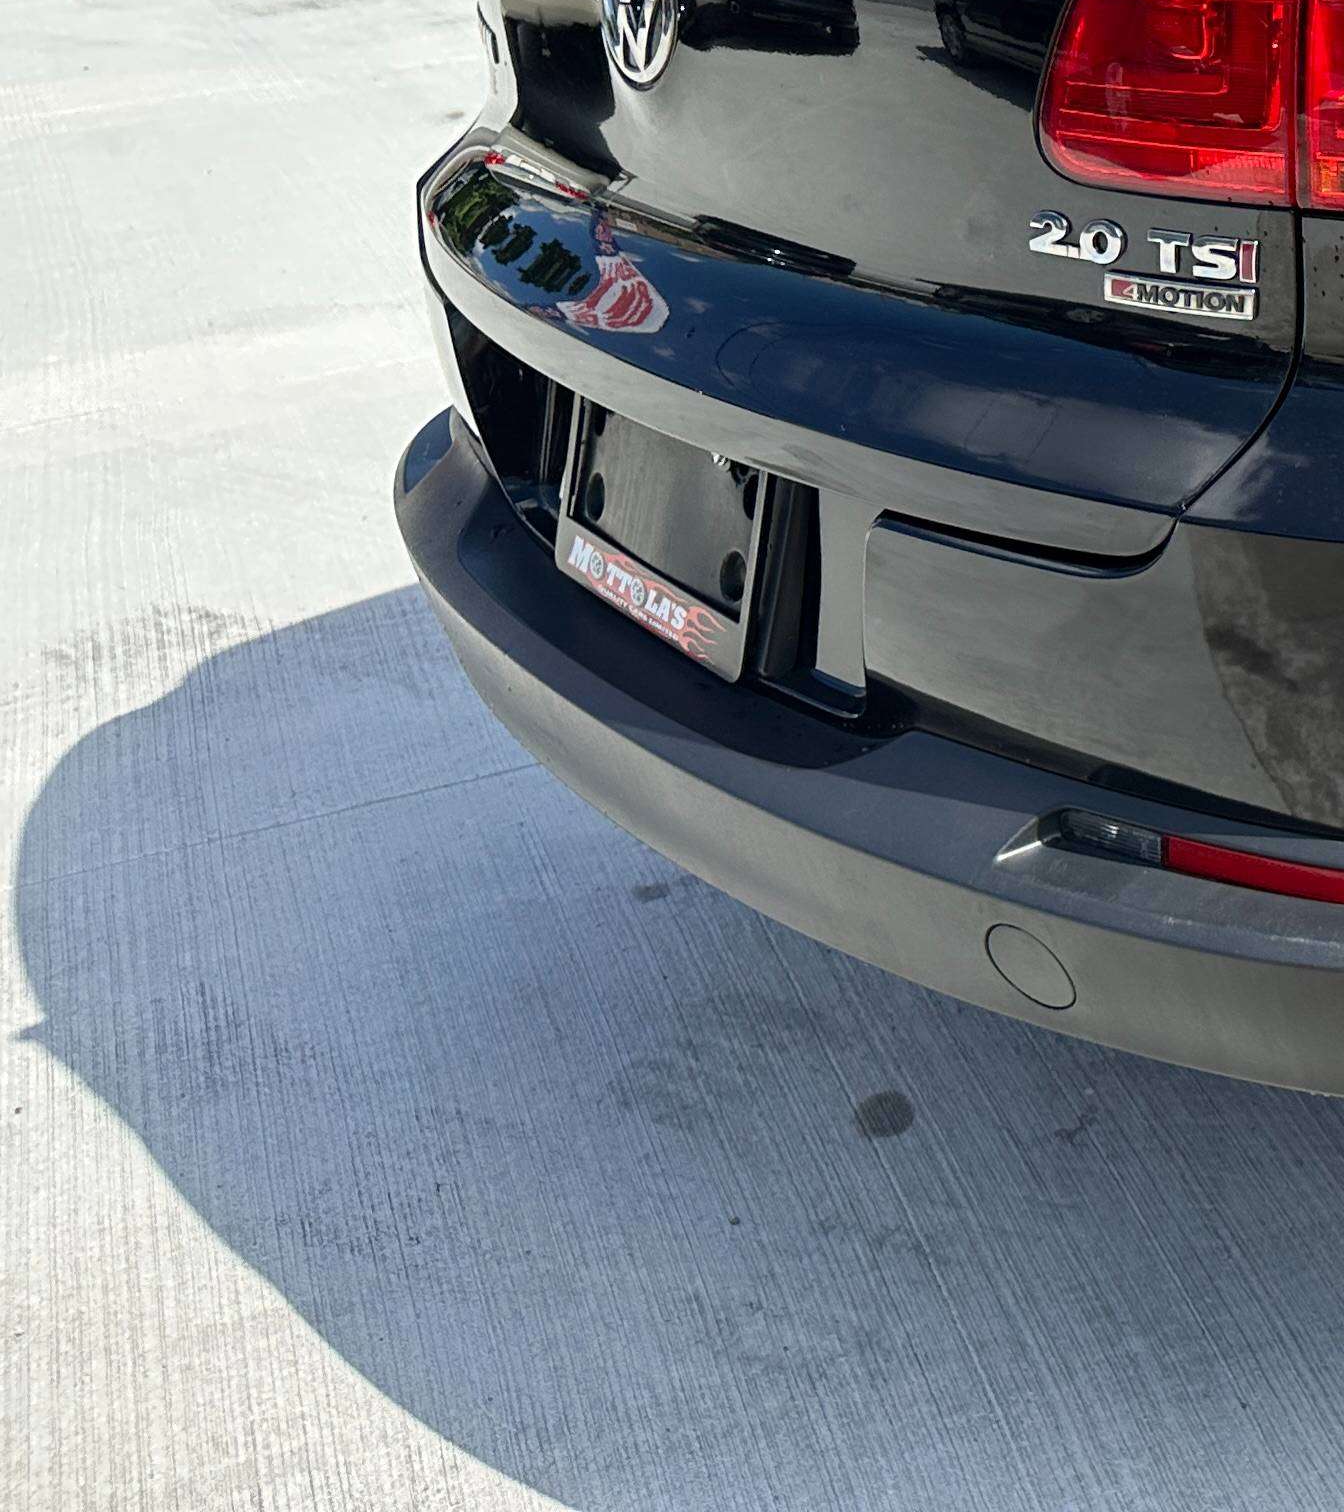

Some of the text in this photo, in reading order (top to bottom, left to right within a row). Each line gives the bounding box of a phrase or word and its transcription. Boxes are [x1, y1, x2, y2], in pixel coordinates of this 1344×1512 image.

[1028, 209, 1258, 284] 2.0 TSI
[1111, 278, 1246, 314] 4MOTION
[567, 534, 688, 630] MOTTOLA'S
